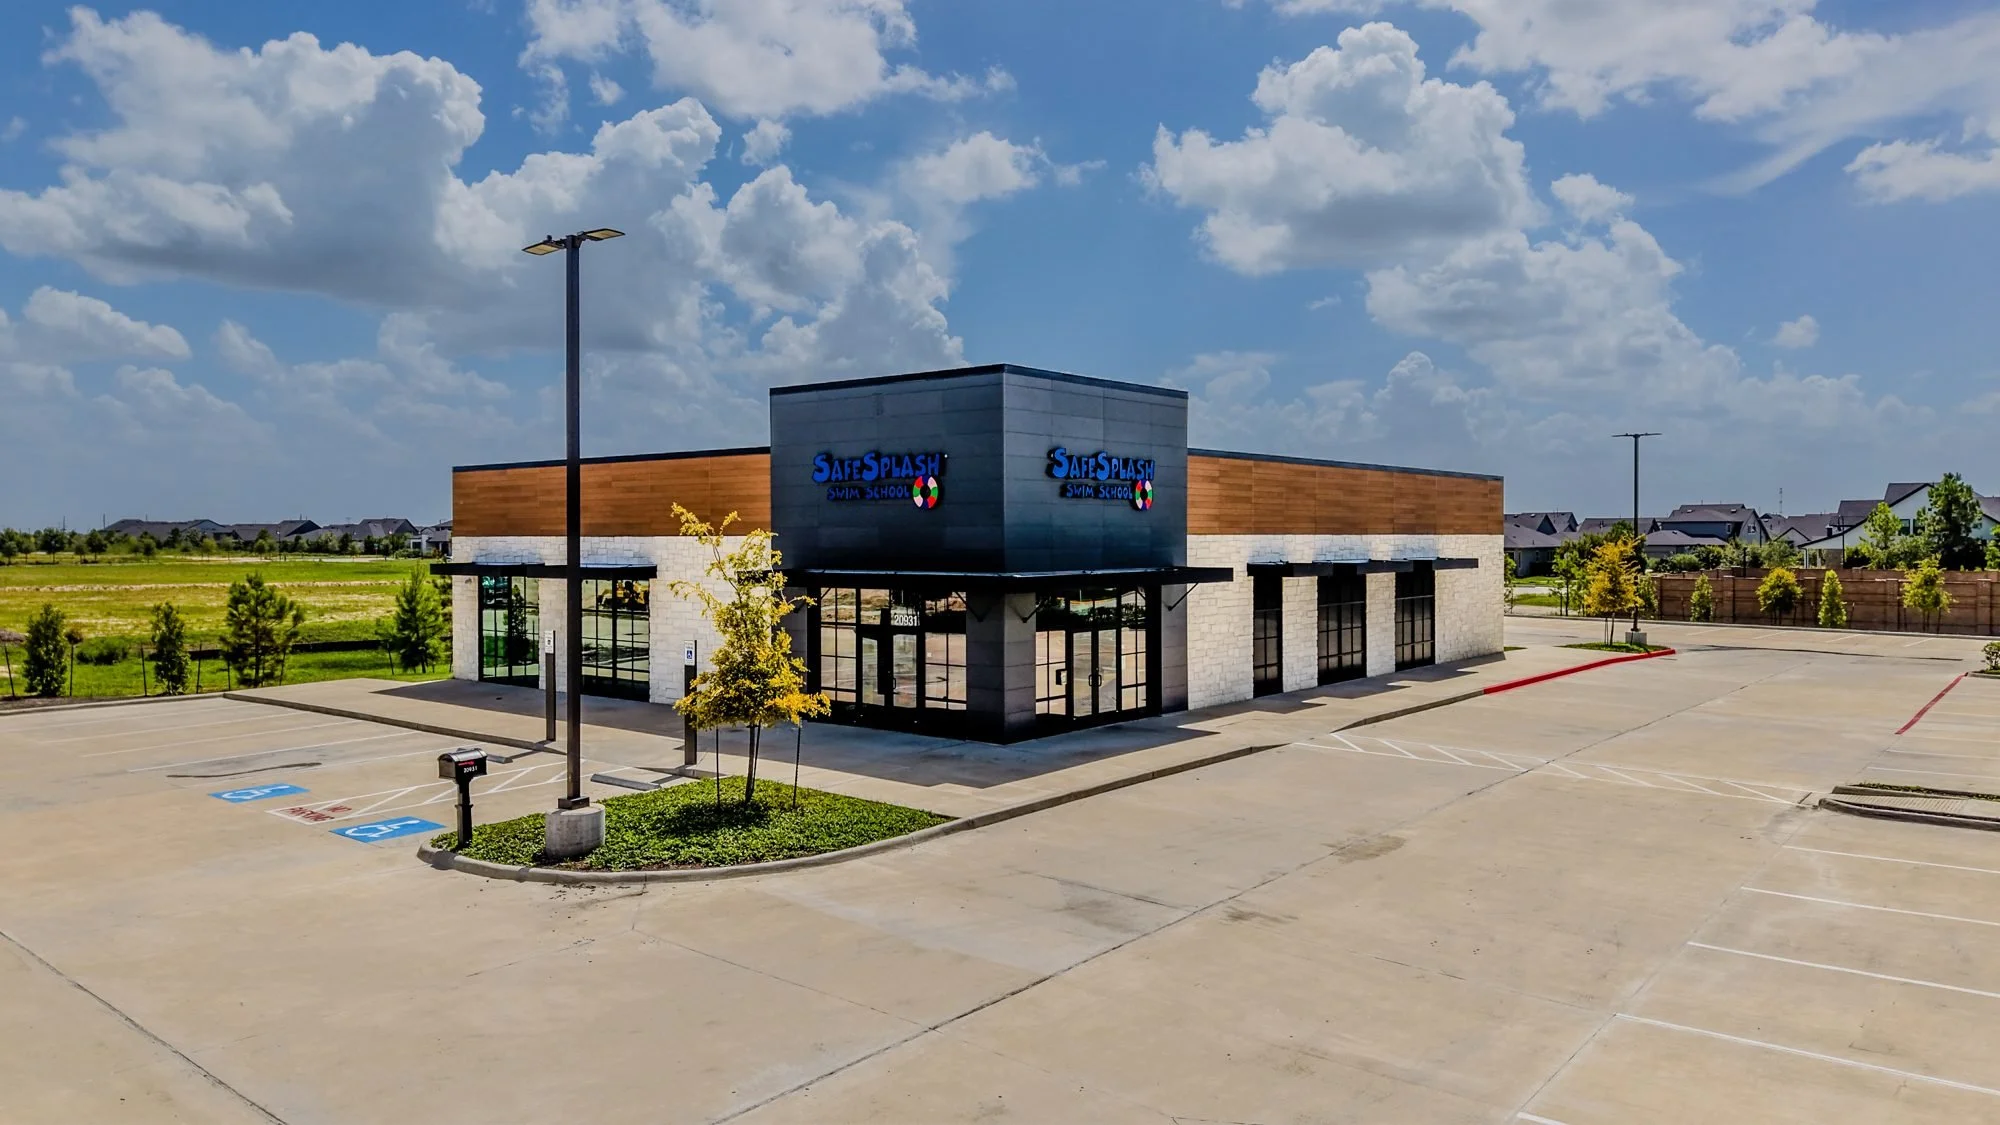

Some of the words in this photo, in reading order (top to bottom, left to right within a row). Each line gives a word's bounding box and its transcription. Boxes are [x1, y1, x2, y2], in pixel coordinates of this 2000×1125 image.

[827, 486, 860, 500] SWIM
[866, 484, 911, 499] SCHOOL
[1066, 483, 1095, 498] SWIM
[1099, 485, 1133, 500] SCHOOL
[894, 614, 918, 627] 20931
